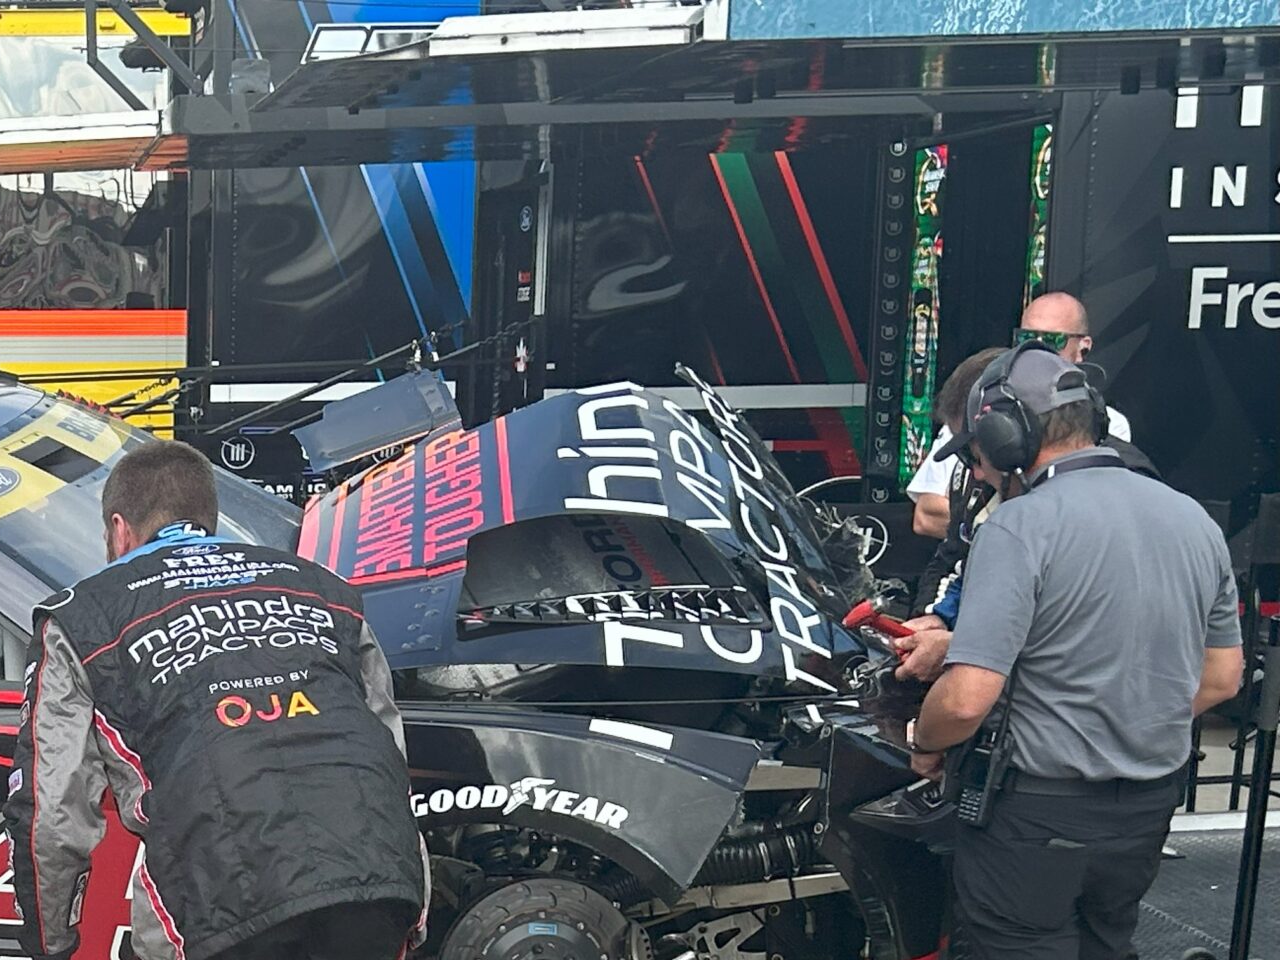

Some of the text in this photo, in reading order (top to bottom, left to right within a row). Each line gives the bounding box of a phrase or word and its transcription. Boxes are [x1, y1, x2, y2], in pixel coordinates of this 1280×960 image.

[423, 430, 485, 564] TOUGHER
[128, 596, 334, 663] mahindra
[152, 616, 329, 667] COMPACT
[151, 632, 339, 684] TRACTORS
[208, 670, 309, 694] POWERED BY
[215, 691, 320, 727] OJA
[410, 783, 630, 830] GOODYEAR
